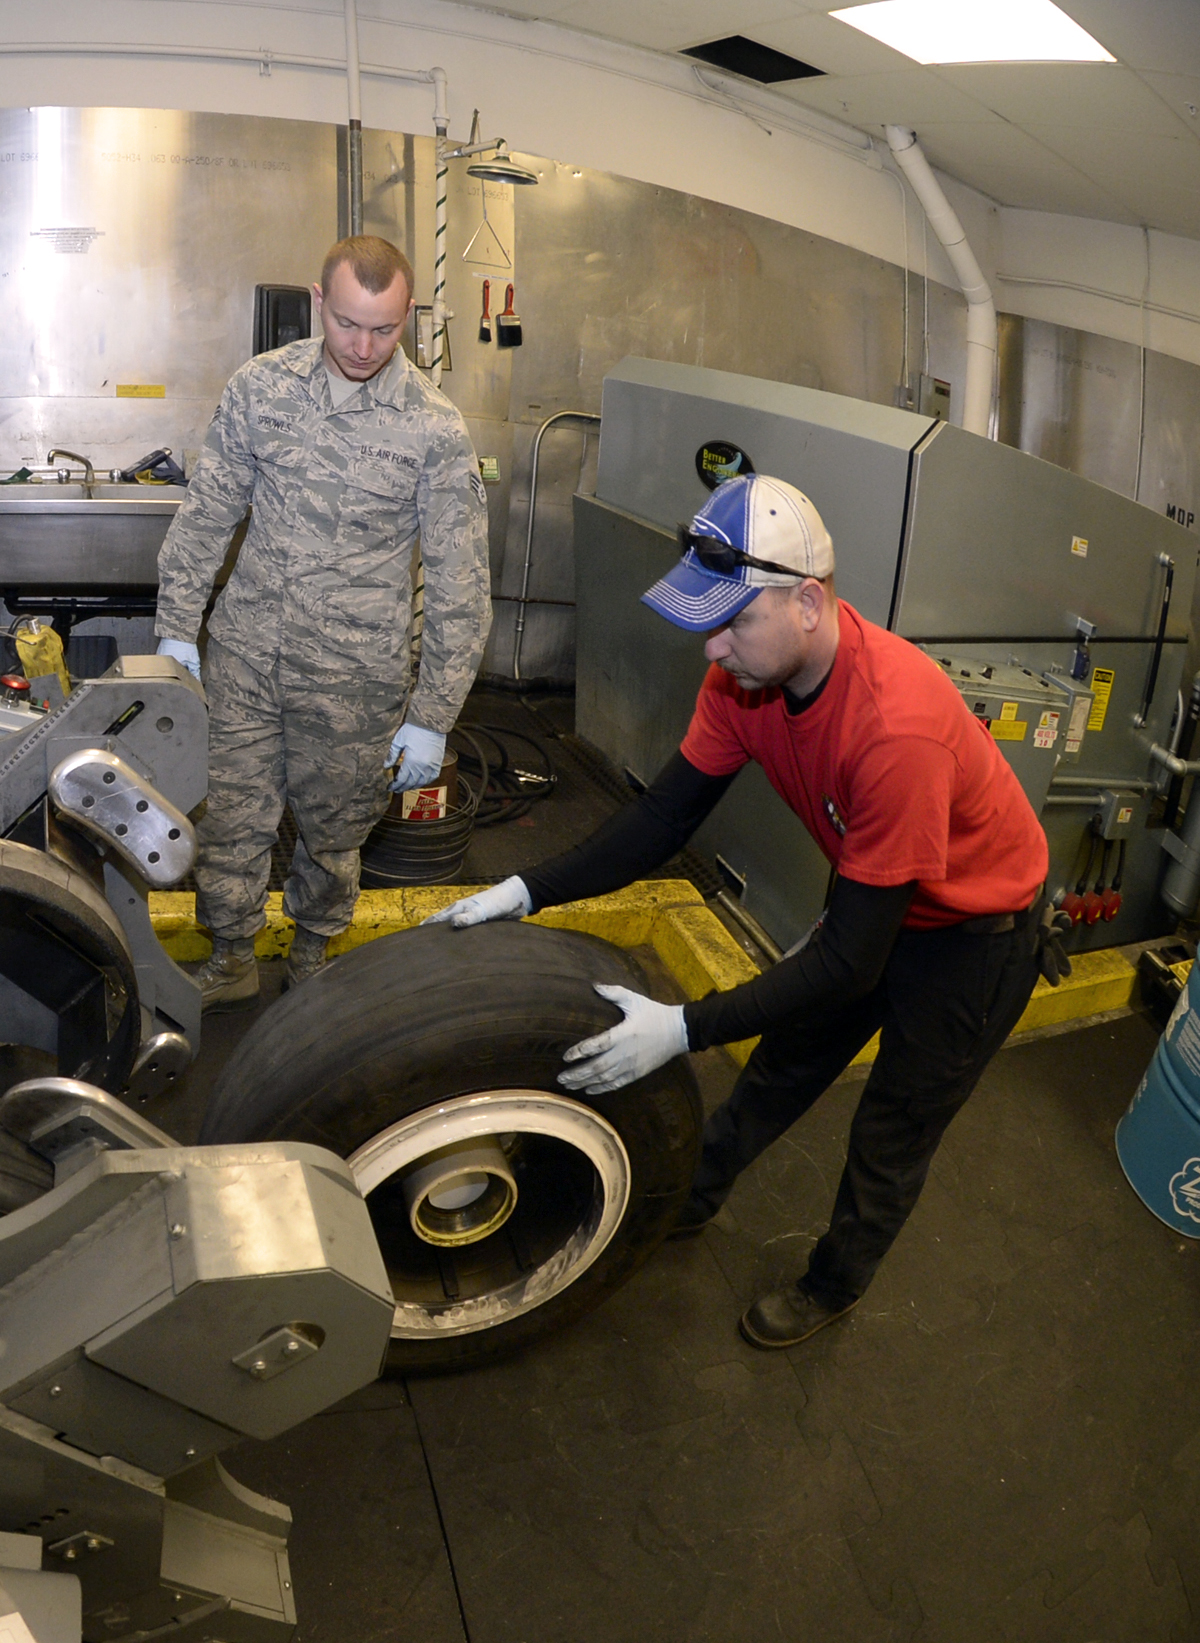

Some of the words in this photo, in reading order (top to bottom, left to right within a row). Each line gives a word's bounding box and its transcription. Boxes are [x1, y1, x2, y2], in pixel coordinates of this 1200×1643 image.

[256, 413, 292, 434] SPROWLS
[376, 448, 392, 463] AIR
[392, 452, 418, 469] FORCE
